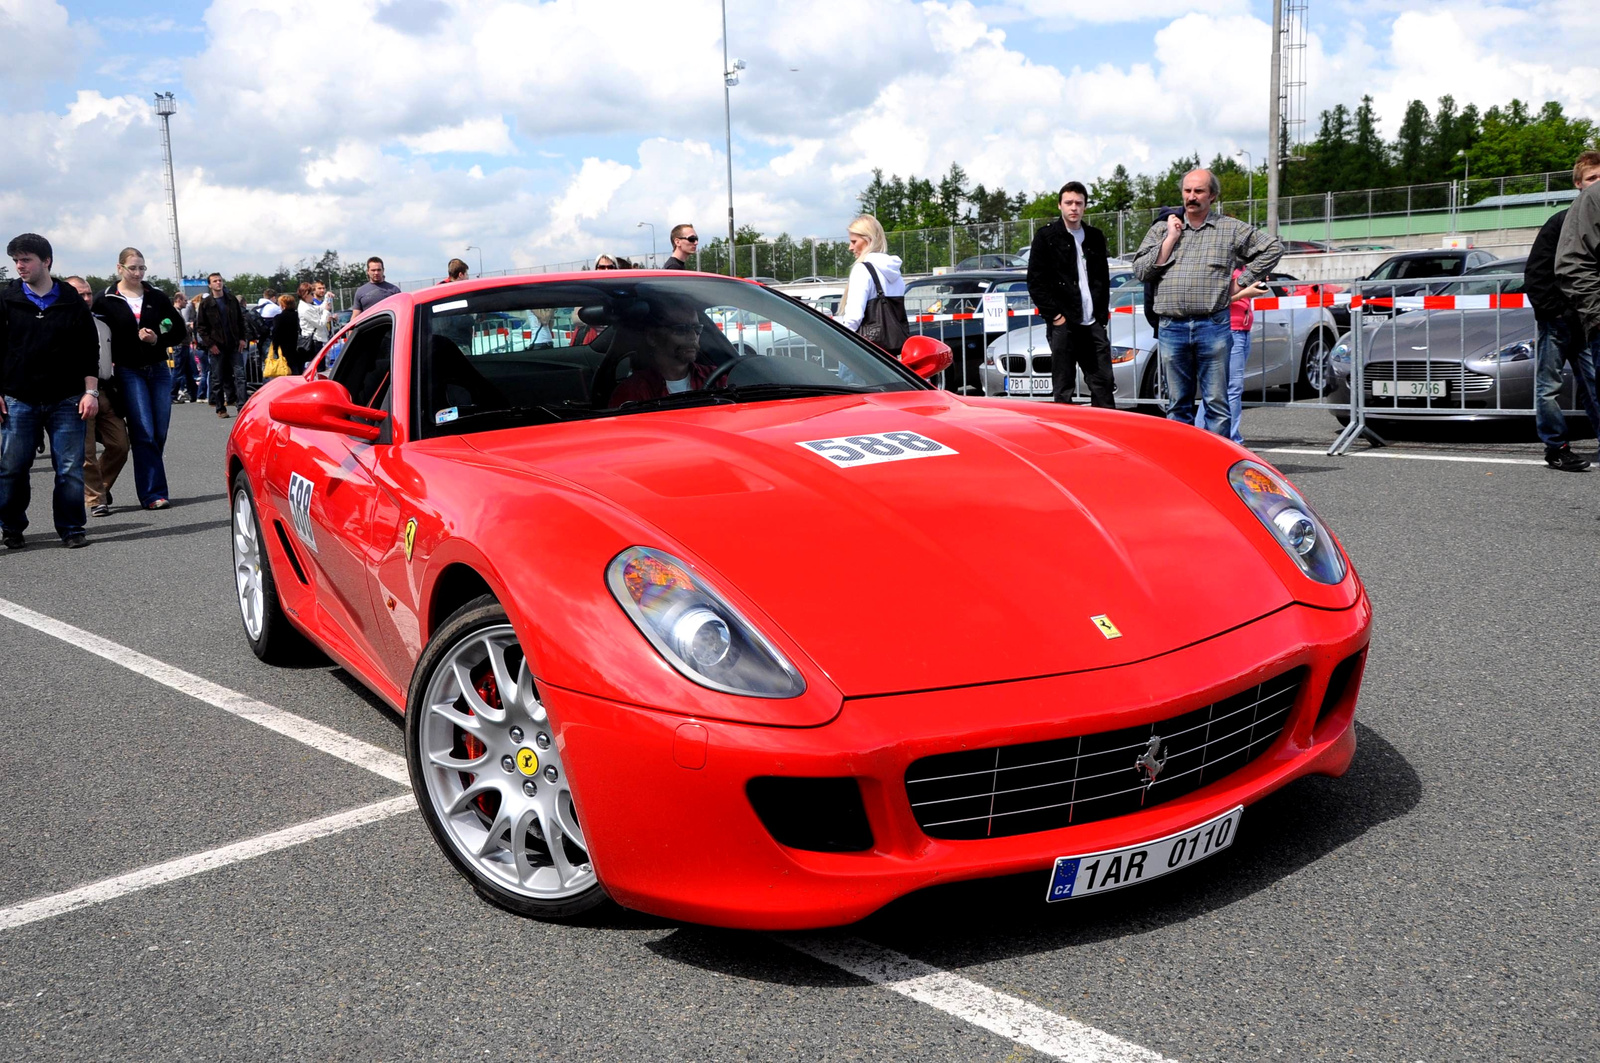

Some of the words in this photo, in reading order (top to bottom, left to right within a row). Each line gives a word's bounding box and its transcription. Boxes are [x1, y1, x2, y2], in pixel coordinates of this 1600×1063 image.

[987, 308, 1003, 318] VIP
[1010, 379, 1024, 389] 7B1
[1382, 382, 1389, 394] A
[1411, 383, 1440, 394] 3756
[804, 432, 943, 461] 588
[289, 474, 314, 541] 588
[1084, 850, 1149, 890] 1AR
[1167, 817, 1233, 869] 0110
[1054, 884, 1072, 895] CZ
